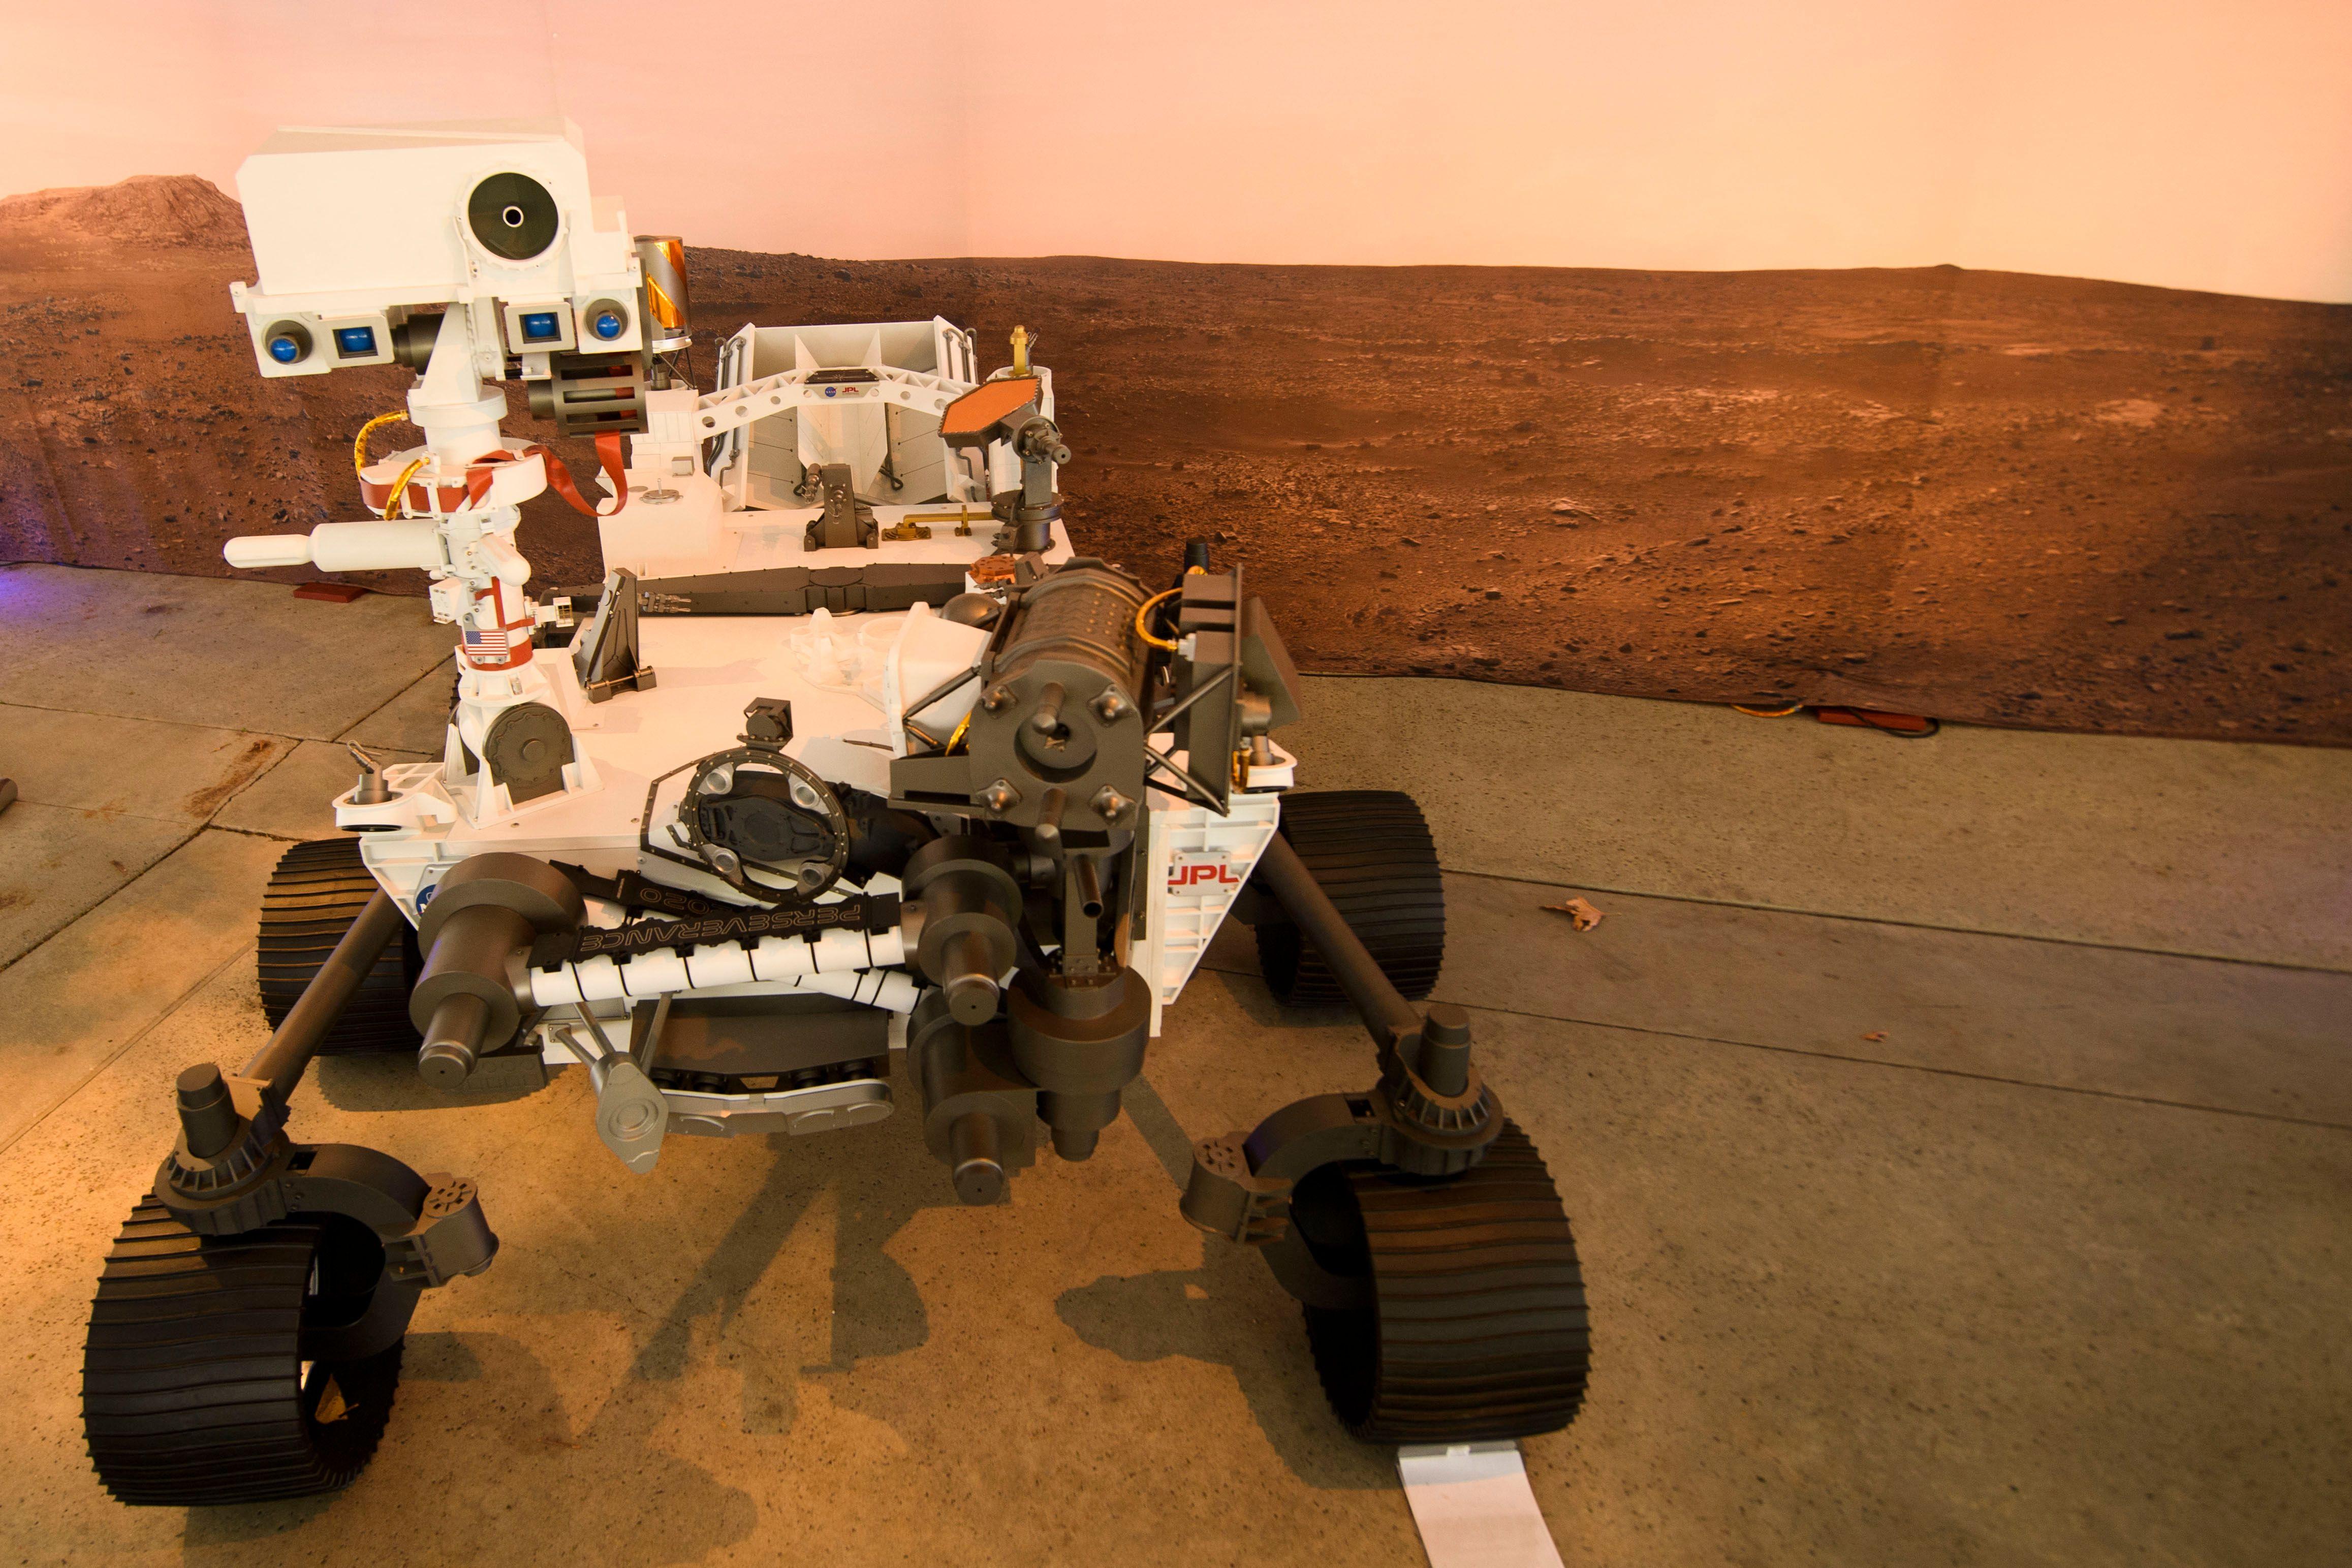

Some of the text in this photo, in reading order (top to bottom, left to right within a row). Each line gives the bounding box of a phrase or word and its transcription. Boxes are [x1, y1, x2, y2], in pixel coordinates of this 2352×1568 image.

[1167, 864, 1239, 885] JPL
[640, 888, 729, 915] 020
[580, 904, 861, 952] PERSEVERANCE
